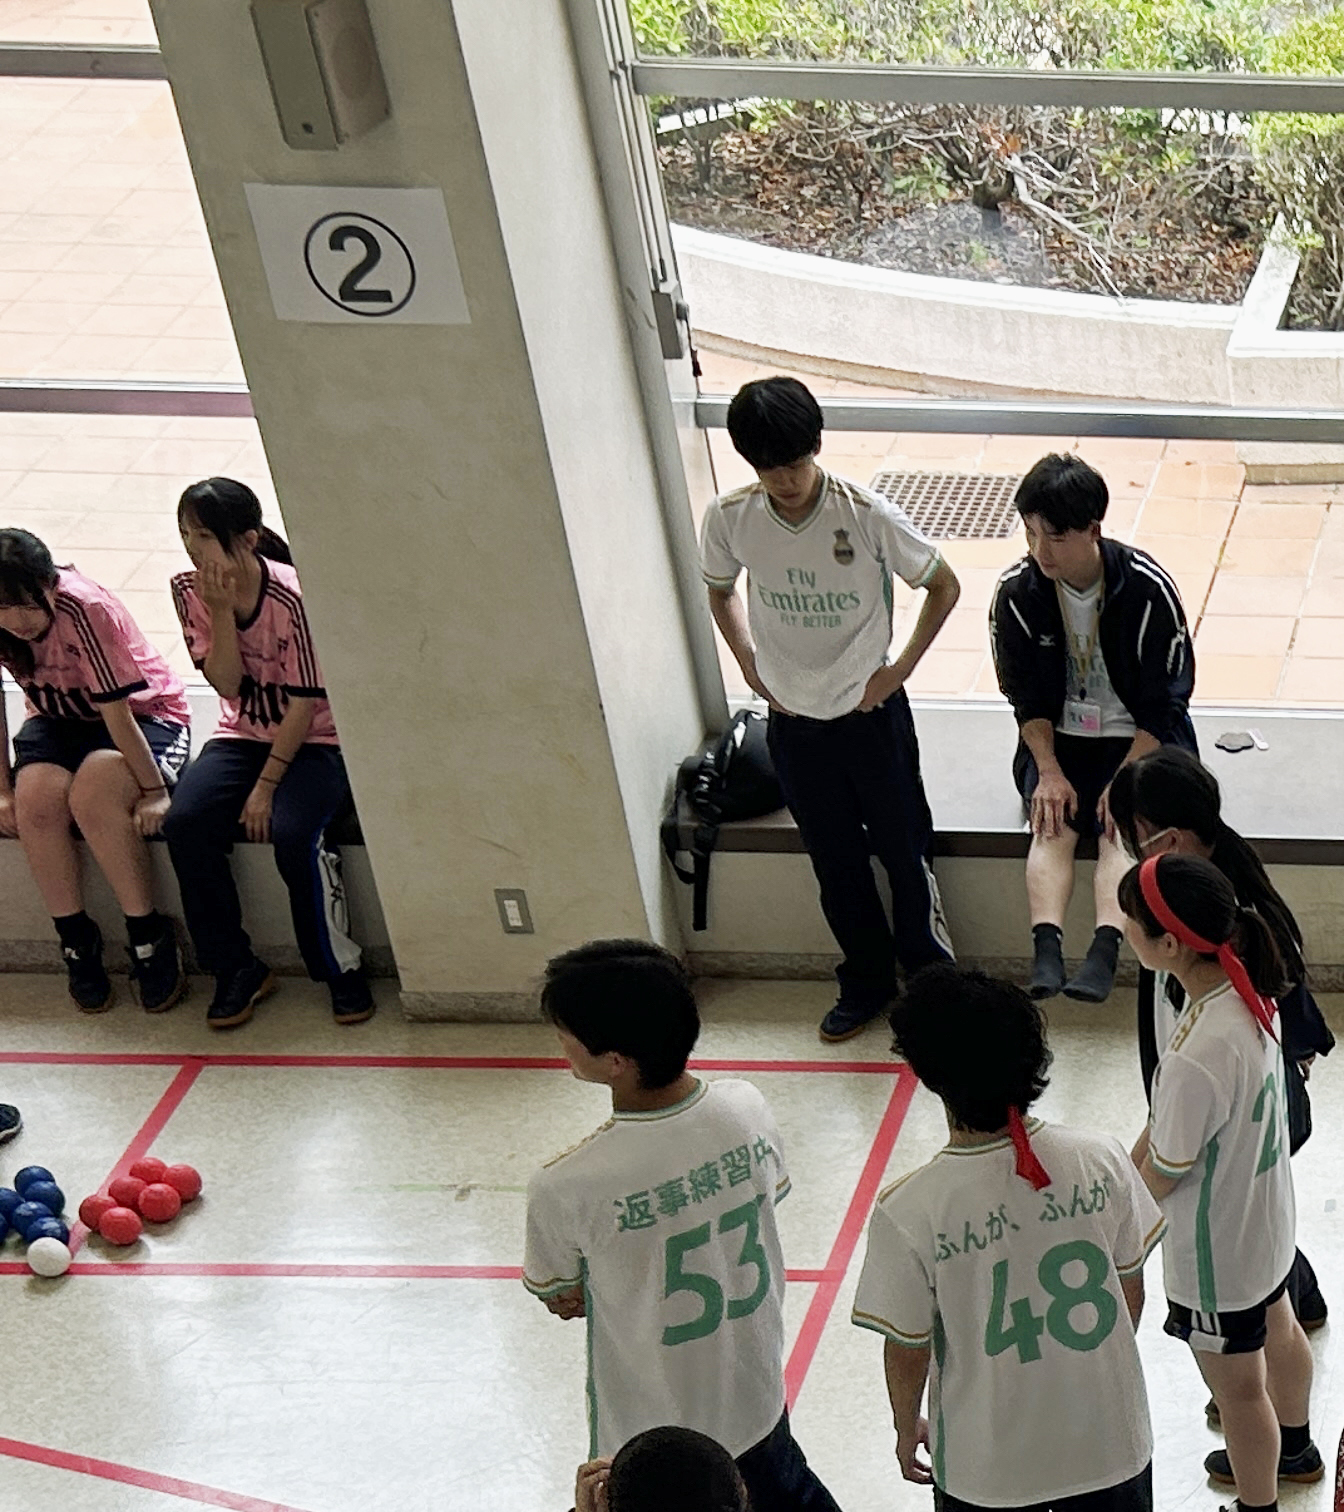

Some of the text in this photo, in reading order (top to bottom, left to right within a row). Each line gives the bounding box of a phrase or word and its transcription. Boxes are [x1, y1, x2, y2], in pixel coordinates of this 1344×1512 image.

[758, 583, 861, 614] Emirates
[662, 1193, 771, 1346] 53
[985, 1239, 1118, 1364] 48
